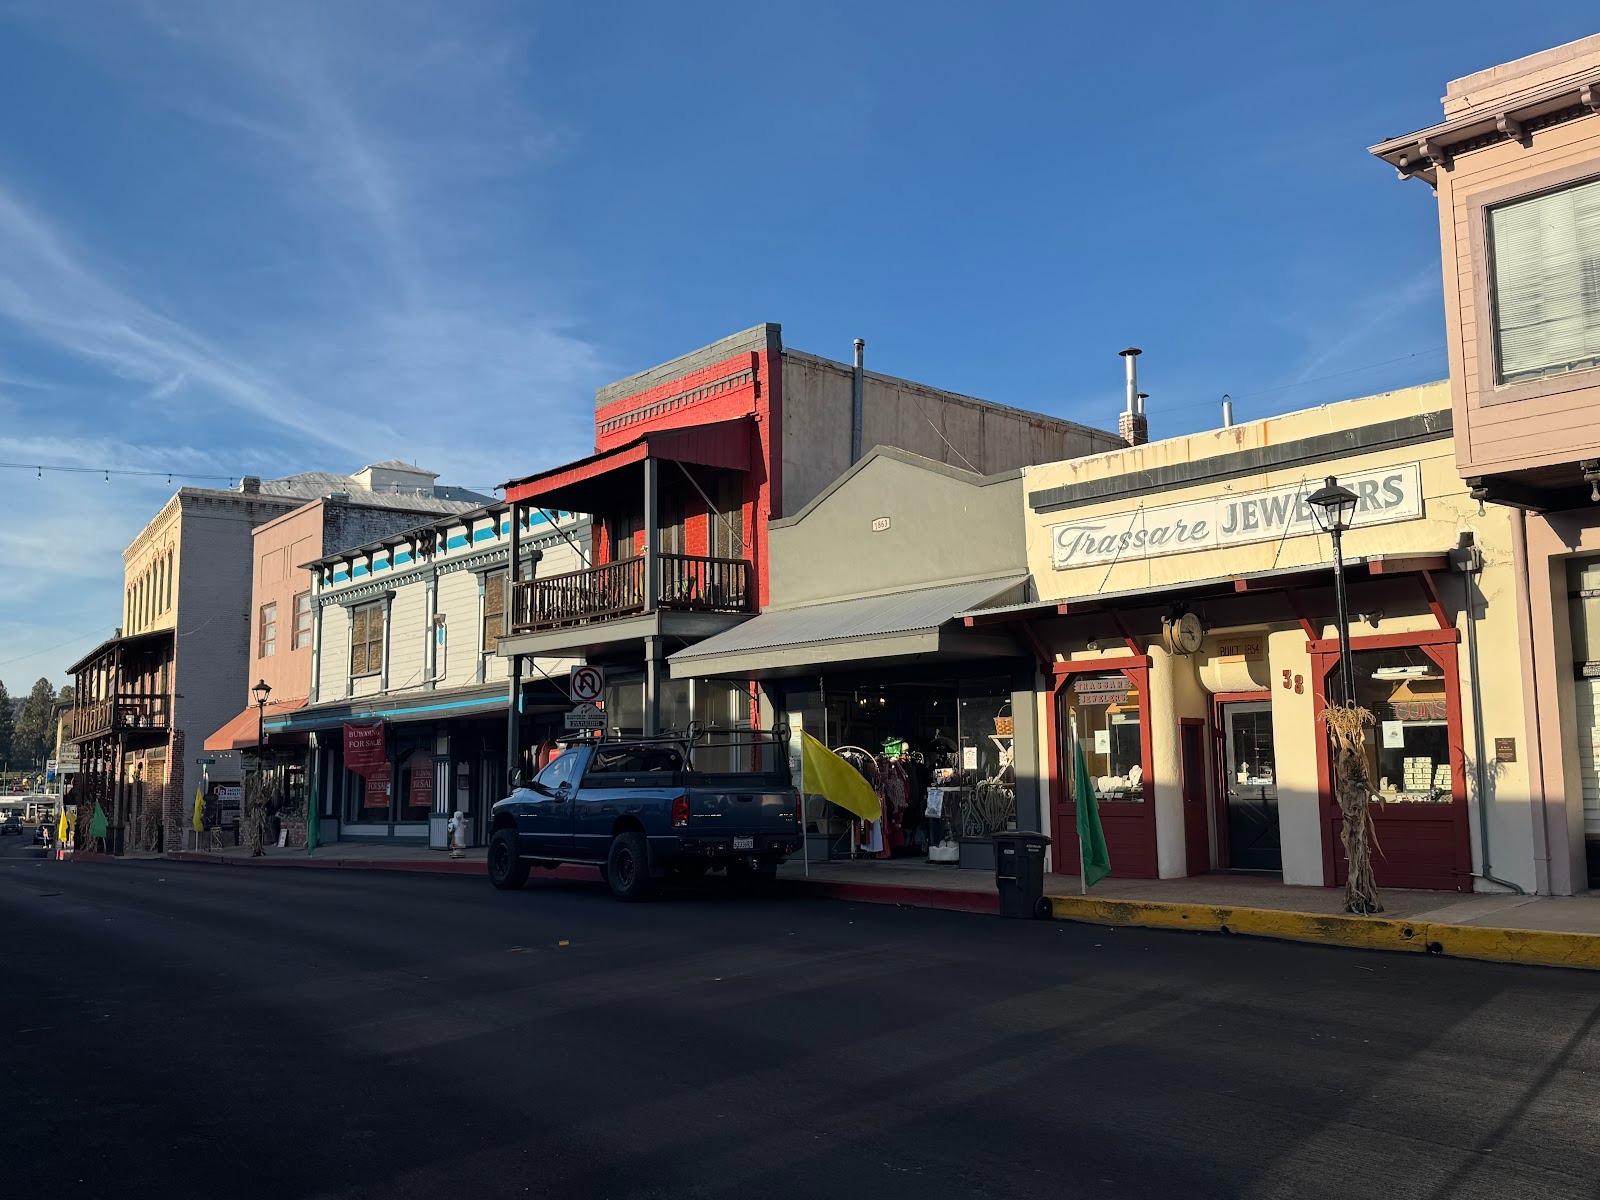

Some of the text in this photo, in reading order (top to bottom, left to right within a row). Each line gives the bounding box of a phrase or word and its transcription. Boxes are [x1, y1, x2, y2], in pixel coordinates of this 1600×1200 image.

[1057, 518, 1210, 563] Trassare
[1219, 645, 1240, 657] BUILT
[1076, 680, 1131, 691] TRASSARE
[1282, 669, 1304, 695] 38
[1081, 694, 1126, 704] JEWELERS
[1395, 701, 1447, 720] COINS
[348, 729, 380, 738] BUILDING
[348, 738, 382, 748] FOR SALE
